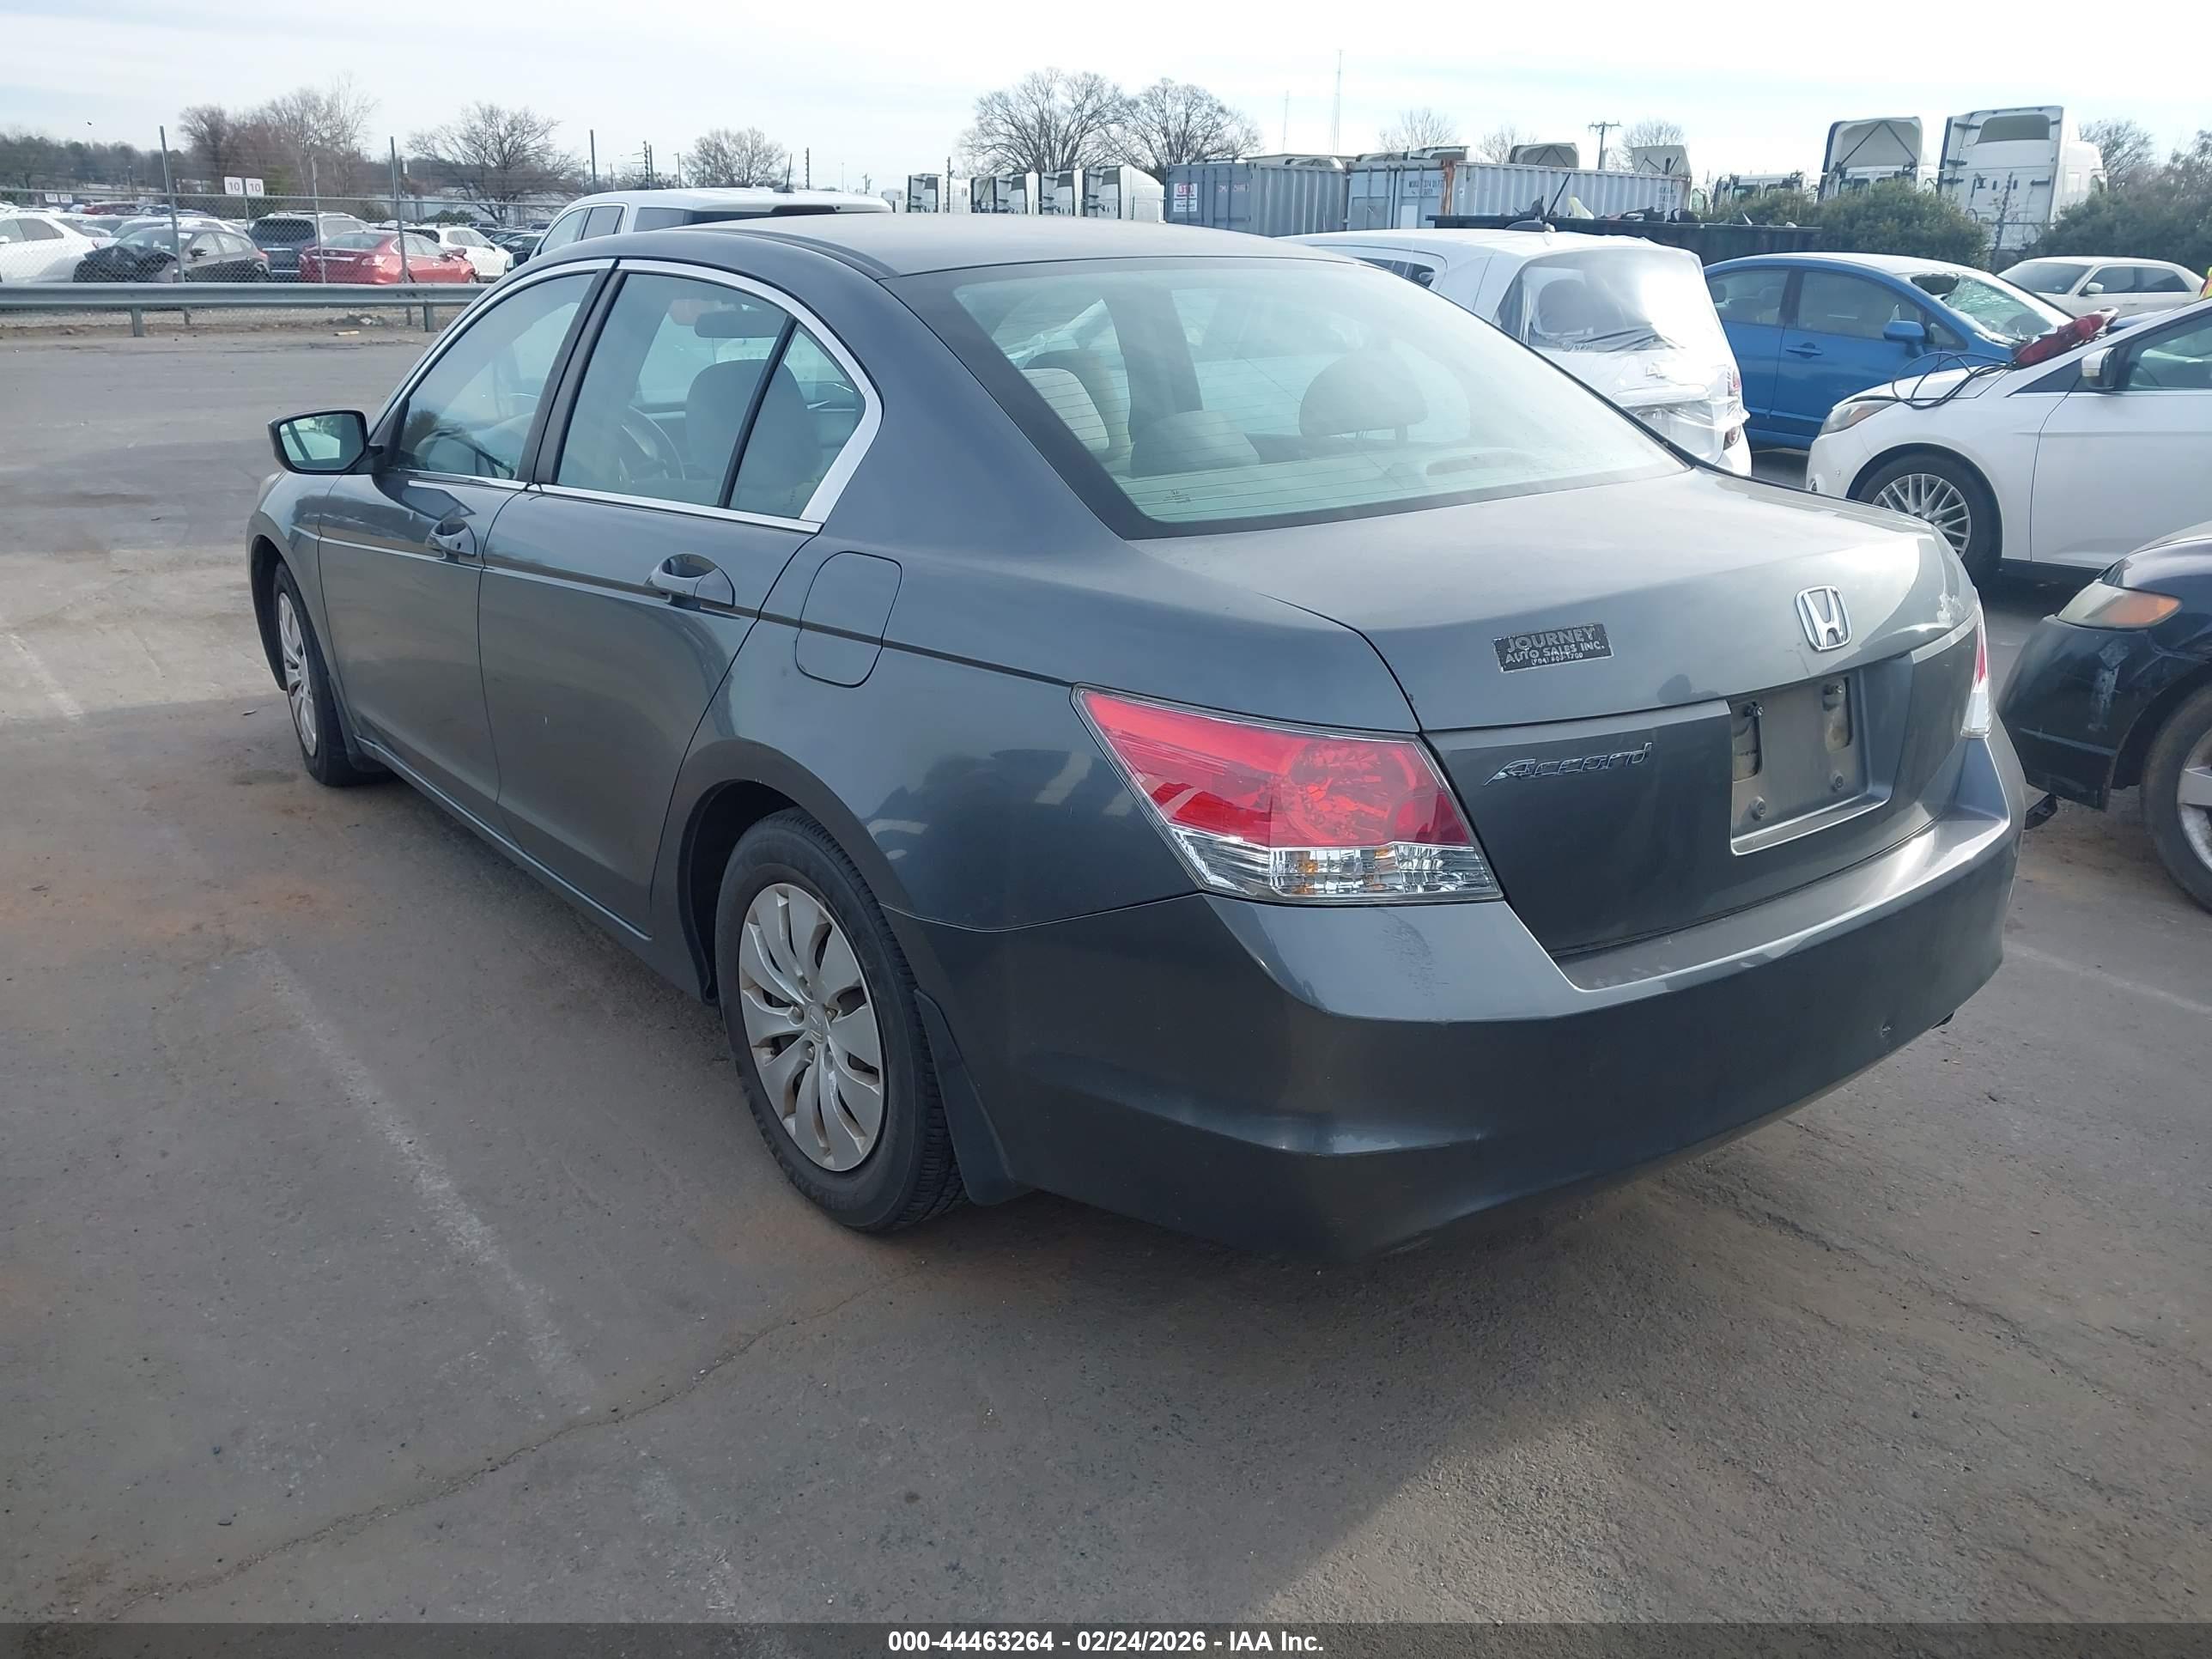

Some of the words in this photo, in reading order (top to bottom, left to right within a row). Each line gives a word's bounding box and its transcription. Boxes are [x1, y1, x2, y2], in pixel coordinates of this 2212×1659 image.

[228, 182, 240, 191] 10
[250, 183, 261, 192] 10
[1507, 626, 1595, 653] JOURNEY
[1505, 649, 1540, 664] AUTO
[1543, 643, 1577, 657] SALES
[1581, 641, 1605, 652] INC.
[1483, 742, 1653, 787] Accord
